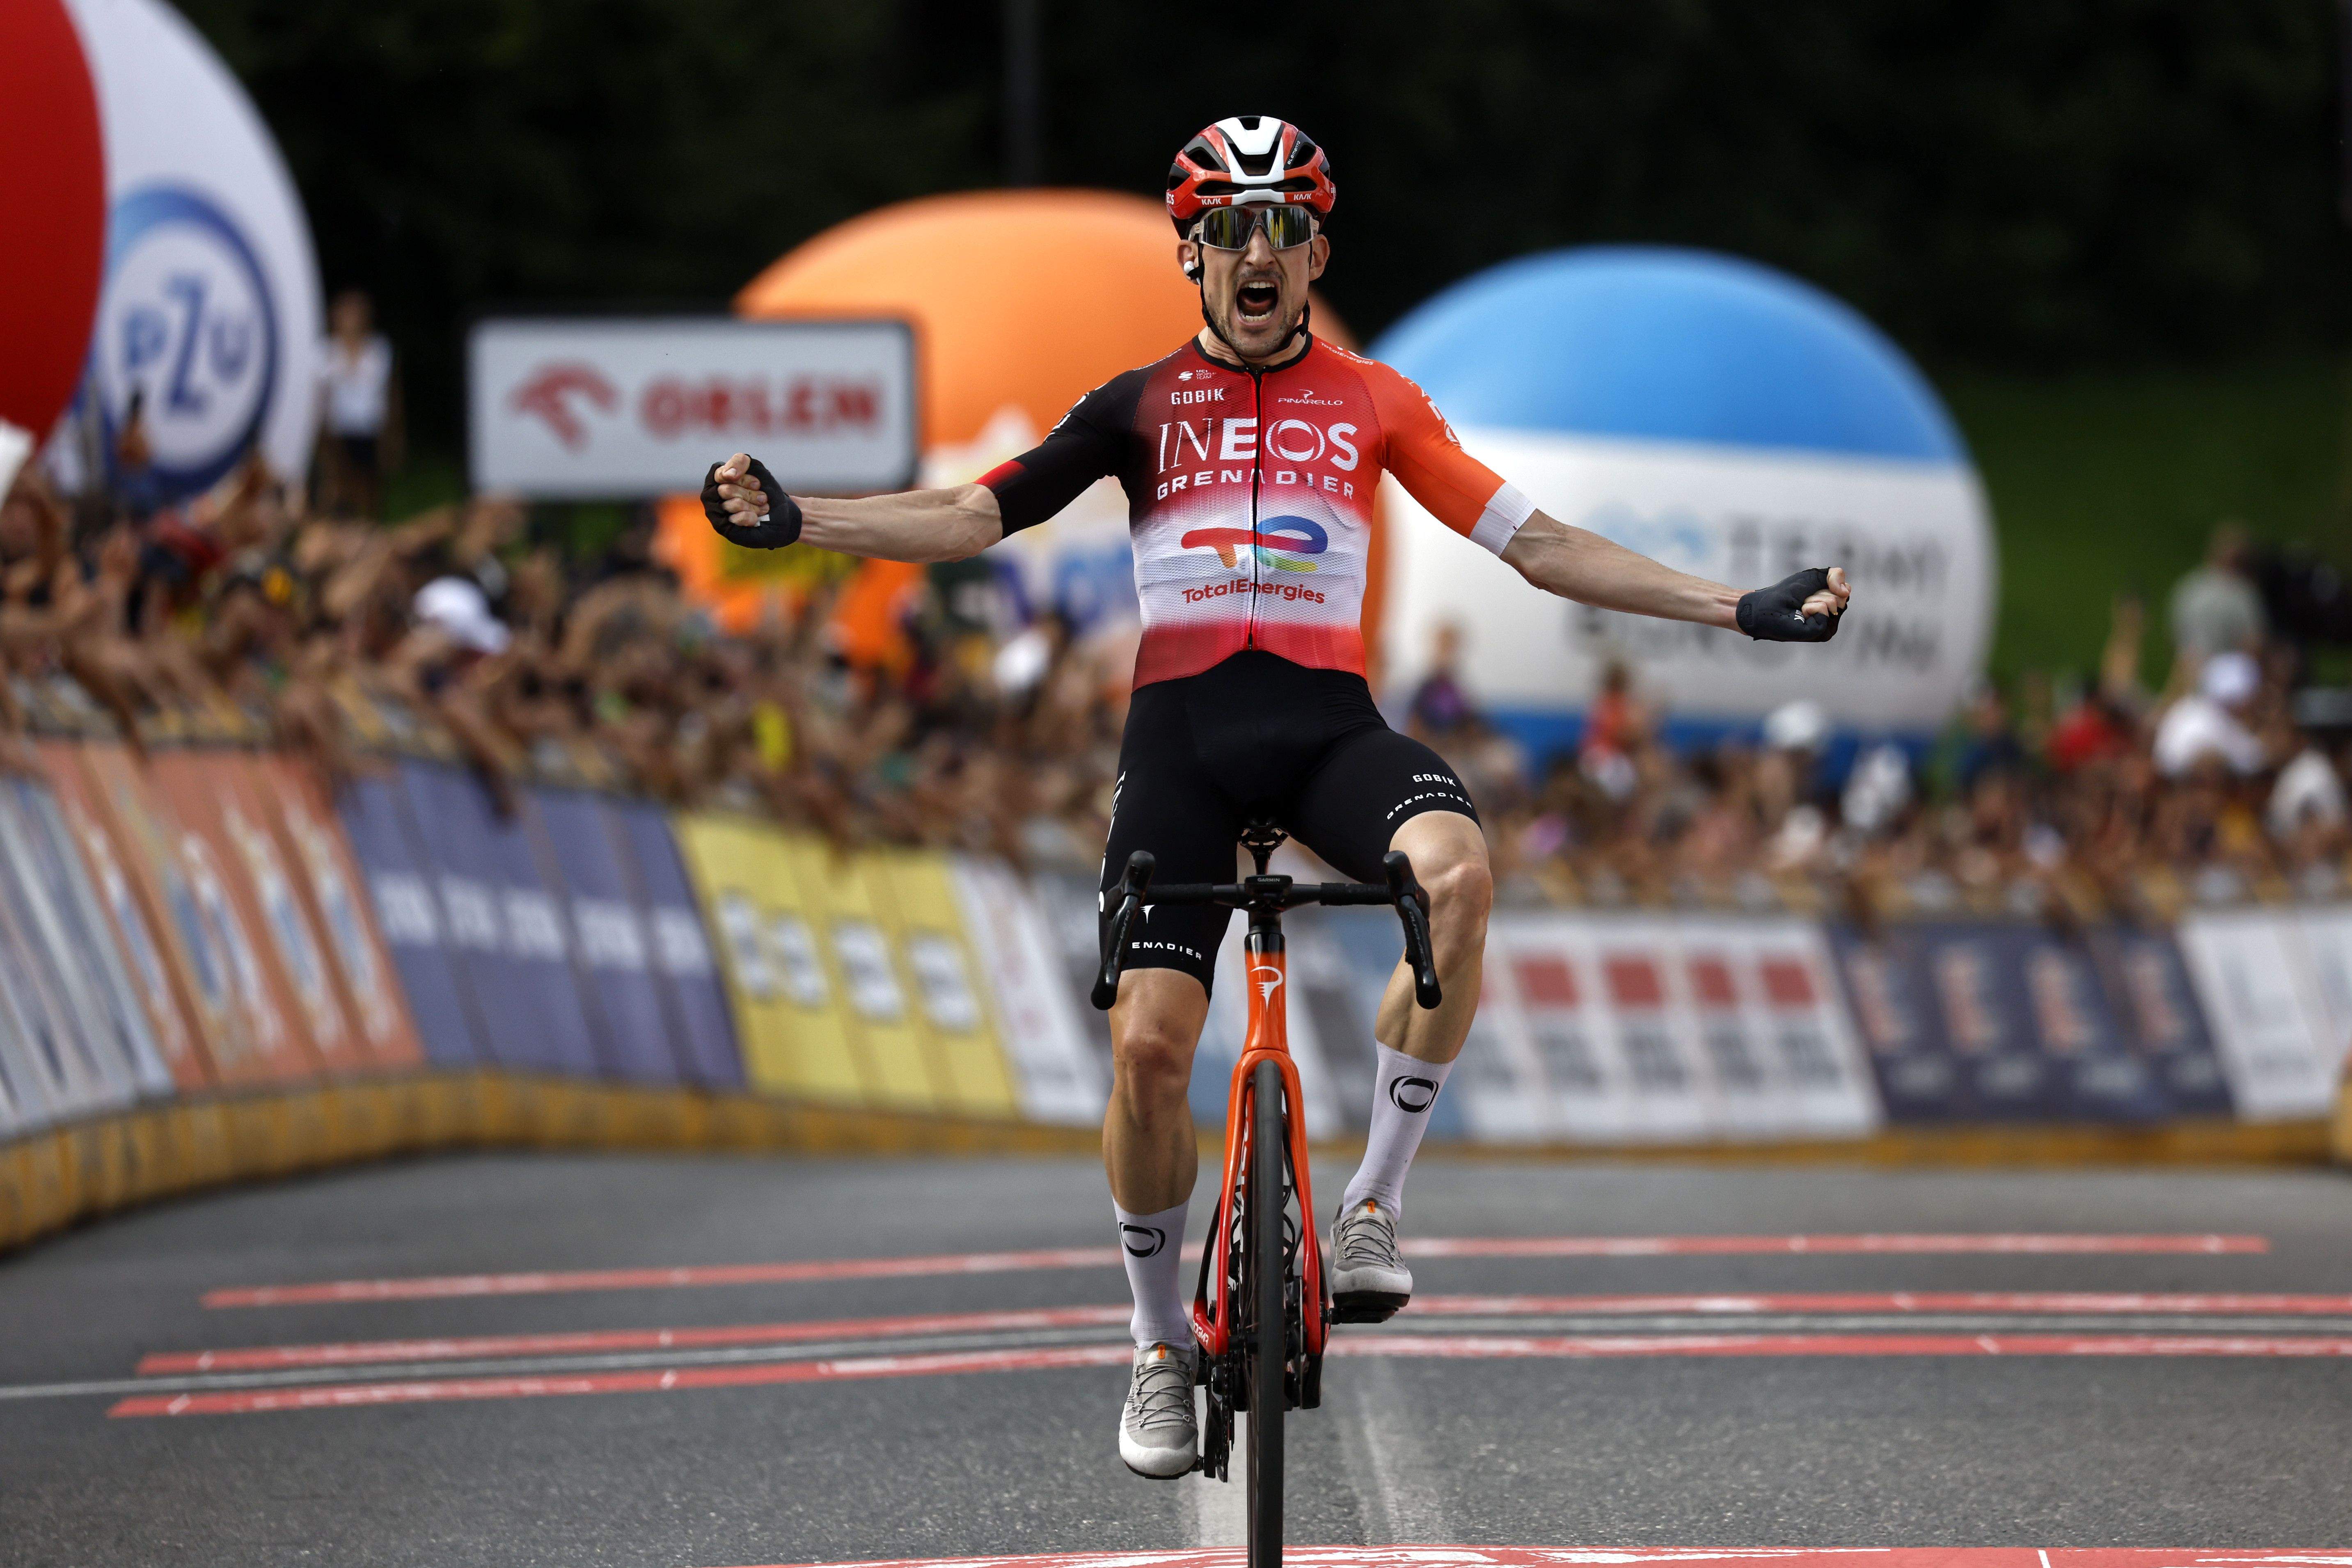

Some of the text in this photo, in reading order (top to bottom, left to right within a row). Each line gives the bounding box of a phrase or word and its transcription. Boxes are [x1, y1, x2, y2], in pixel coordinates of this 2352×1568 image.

[1319, 342, 1374, 366] TotalEnergies
[639, 371, 882, 447] ORLEN
[1171, 387, 1225, 405] GOBIK
[1158, 417, 1359, 474] INEOS
[1157, 469, 1353, 501] GRENADIER
[1182, 578, 1325, 604] TotalEnergies
[1412, 774, 1457, 787] GOBIK
[1386, 792, 1473, 820] GRENADIER
[1131, 942, 1202, 961] ENADIER
